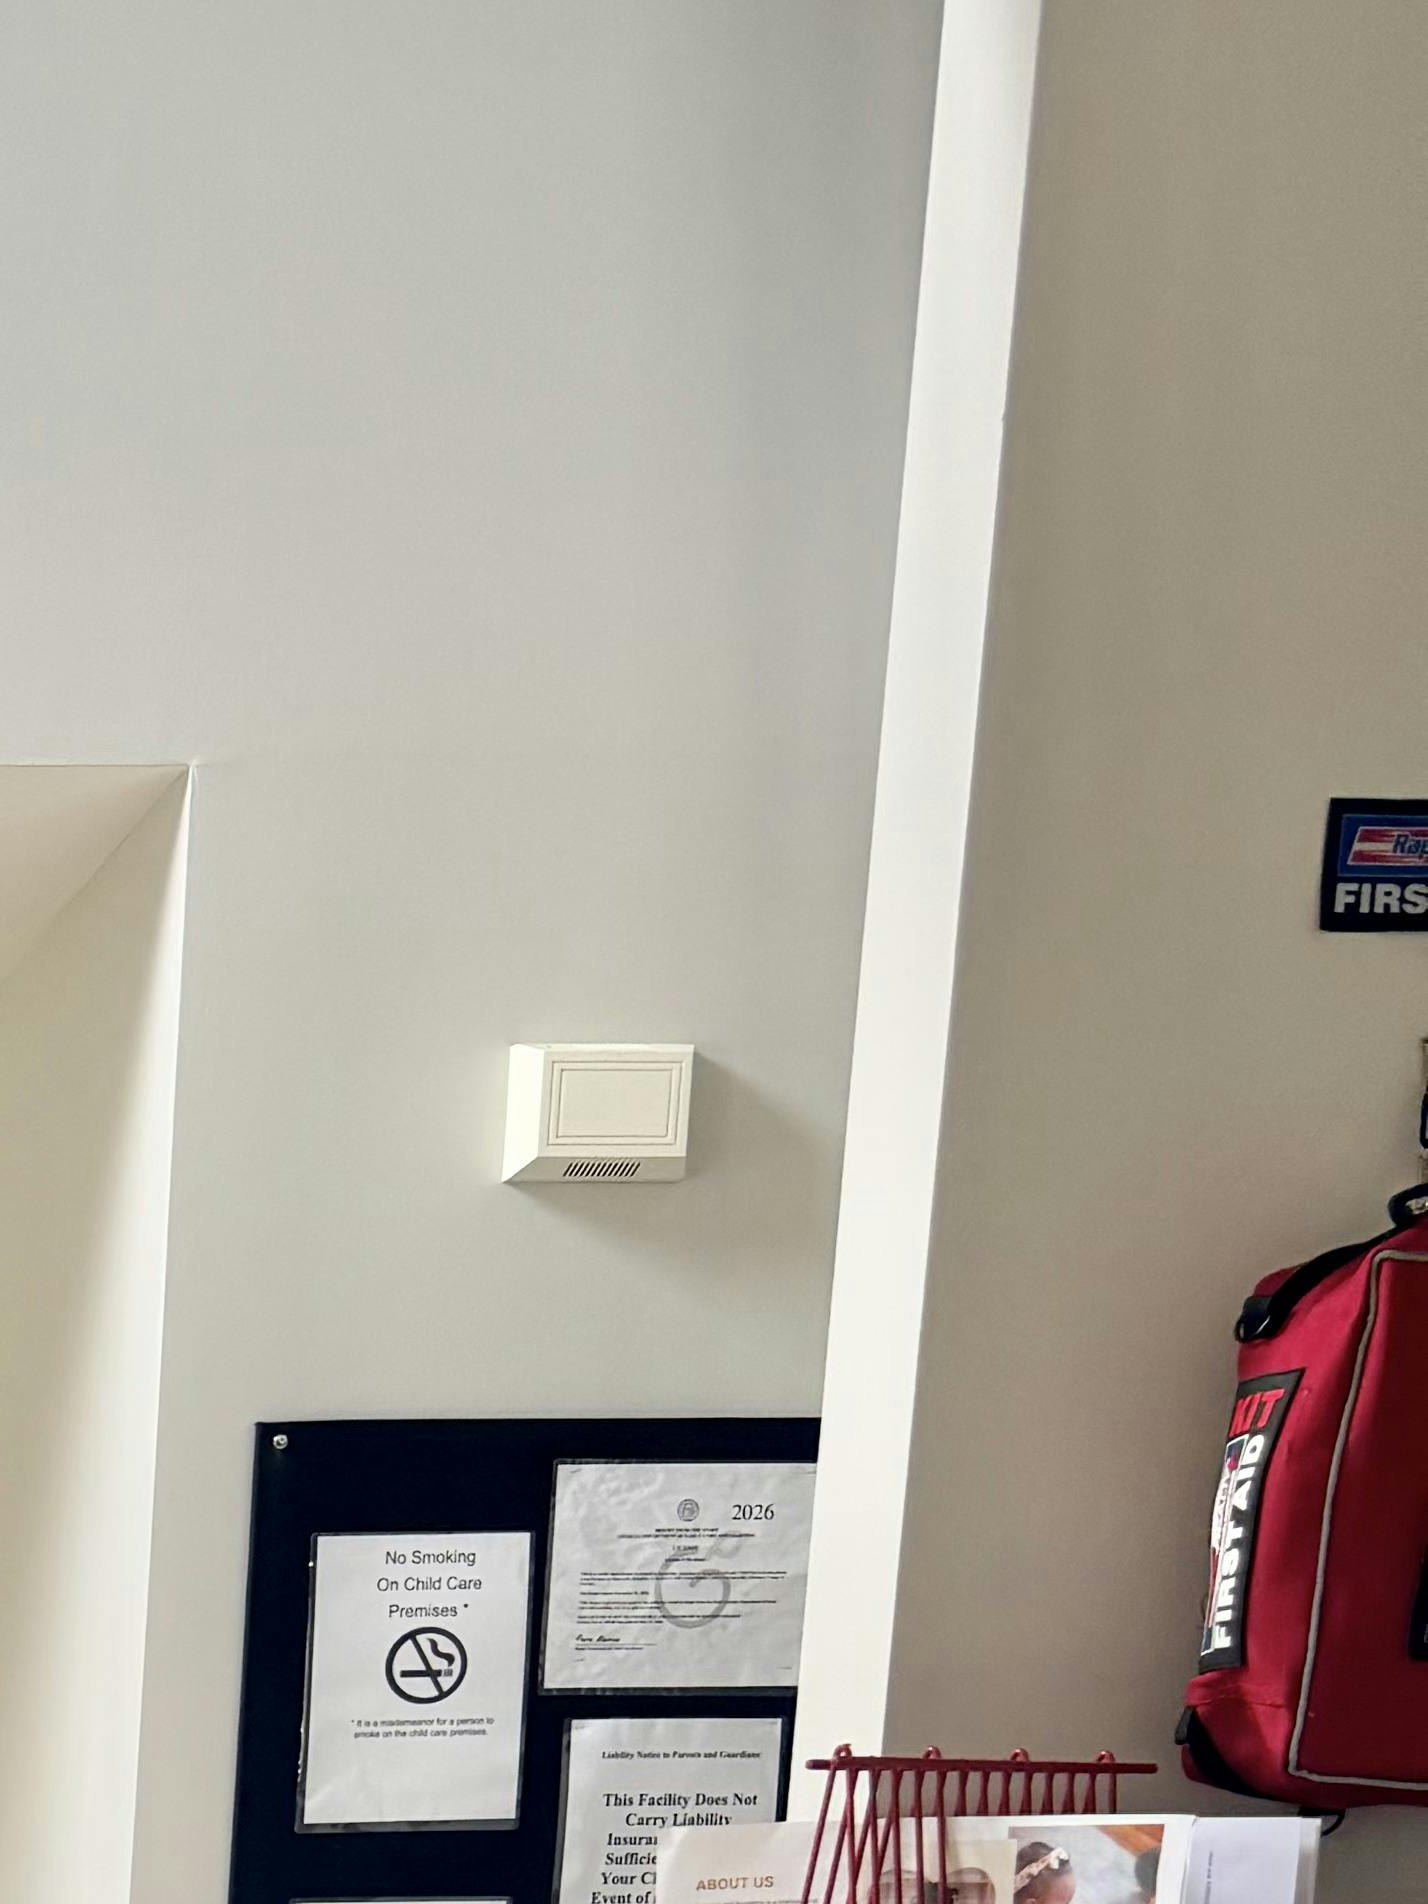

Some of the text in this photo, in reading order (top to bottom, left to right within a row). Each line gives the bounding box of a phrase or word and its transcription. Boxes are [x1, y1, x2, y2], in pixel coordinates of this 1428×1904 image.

[731, 1503, 775, 1521] 2026
[1213, 1519, 1245, 1649] FIRST
[1233, 1434, 1265, 1511] AID
[385, 1549, 477, 1567] No Smoking
[376, 1575, 482, 1592] On Child Care
[388, 1603, 458, 1618] Premises
[436, 1717, 448, 1726] for
[456, 1718, 486, 1728] person
[395, 1729, 407, 1738] the
[409, 1729, 429, 1738] child
[601, 1751, 635, 1760] Liability
[703, 1751, 718, 1759] and
[603, 1792, 758, 1809] This Facility Does Not
[625, 1812, 732, 1829] Carry Liability
[601, 1871, 637, 1886] Your
[696, 1875, 774, 1891] ABOUT US
[591, 1890, 651, 1904] Event of
